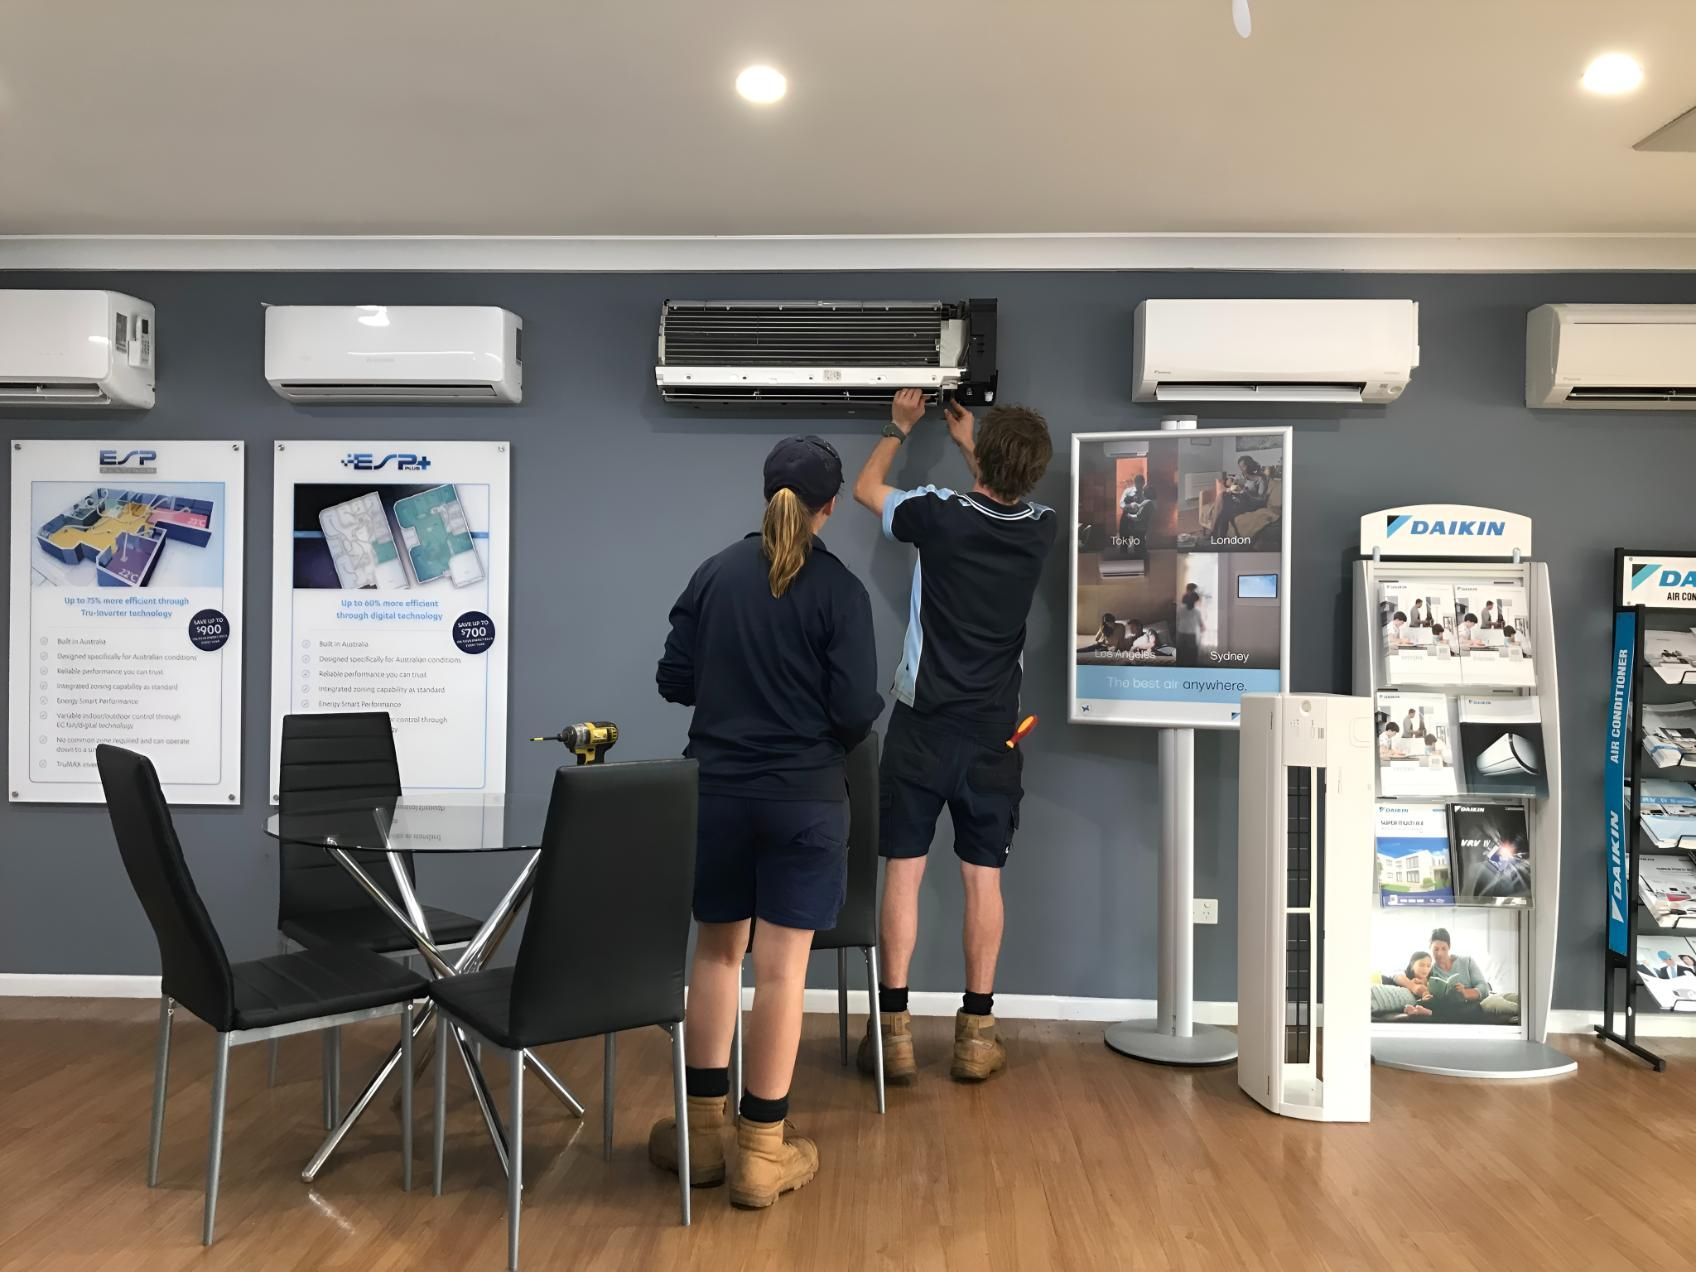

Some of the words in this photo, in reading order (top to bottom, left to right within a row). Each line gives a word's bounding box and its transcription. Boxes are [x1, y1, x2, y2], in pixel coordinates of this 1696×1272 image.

[100, 450, 156, 465] ESP
[1410, 521, 1505, 536] DAIKIN
[1110, 536, 1140, 547] Tokyo
[1211, 536, 1251, 545] London
[64, 597, 75, 606] Up
[125, 597, 156, 605] efficient
[158, 597, 189, 606] through
[1667, 592, 1679, 600] AIR
[341, 600, 352, 608] Up
[129, 610, 172, 619] technology
[337, 612, 369, 620] through
[370, 612, 396, 620] digital
[398, 613, 443, 621] technology
[197, 624, 221, 635] $900
[461, 627, 486, 638] $700
[1095, 650, 1113, 658] Los
[1115, 650, 1156, 660] Angeles
[1210, 651, 1249, 663] Sydney
[1133, 678, 1160, 688] best
[1183, 680, 1247, 692] anywhere.
[1611, 649, 1628, 738] CONDITIONER
[1611, 741, 1619, 764] AIR
[1611, 811, 1623, 900] DAIKIN
